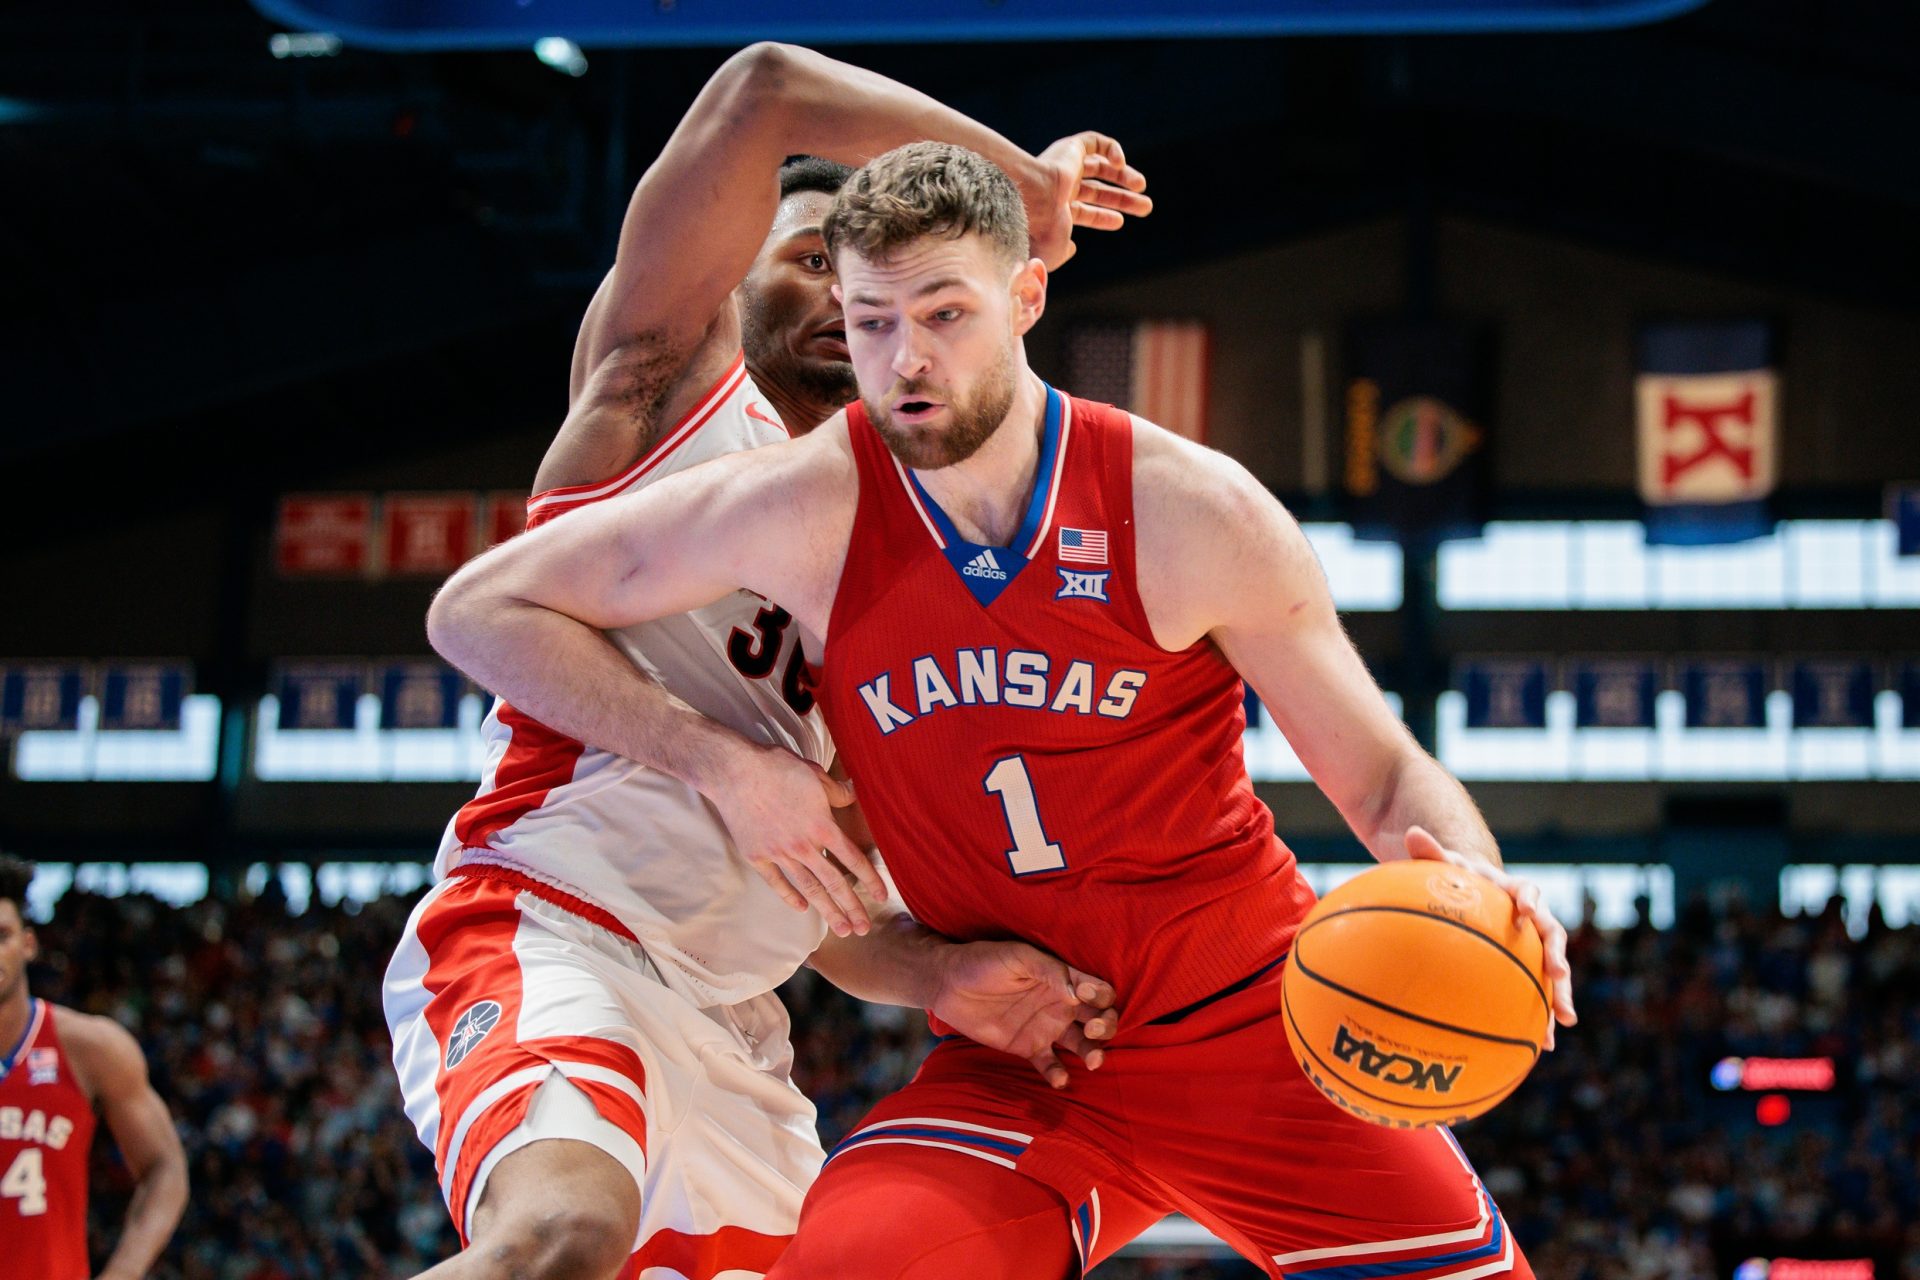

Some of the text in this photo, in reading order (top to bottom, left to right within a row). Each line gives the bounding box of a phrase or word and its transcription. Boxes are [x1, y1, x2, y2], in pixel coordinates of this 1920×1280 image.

[1662, 388, 1754, 491] K
[962, 563, 1007, 580] adidas
[1056, 567, 1110, 602] XII
[857, 646, 1147, 736] KANSAS
[982, 753, 1067, 878] 1
[1332, 1023, 1463, 1092] NCAA
[0, 1106, 74, 1150] SAS
[0, 1147, 47, 1216] 4
